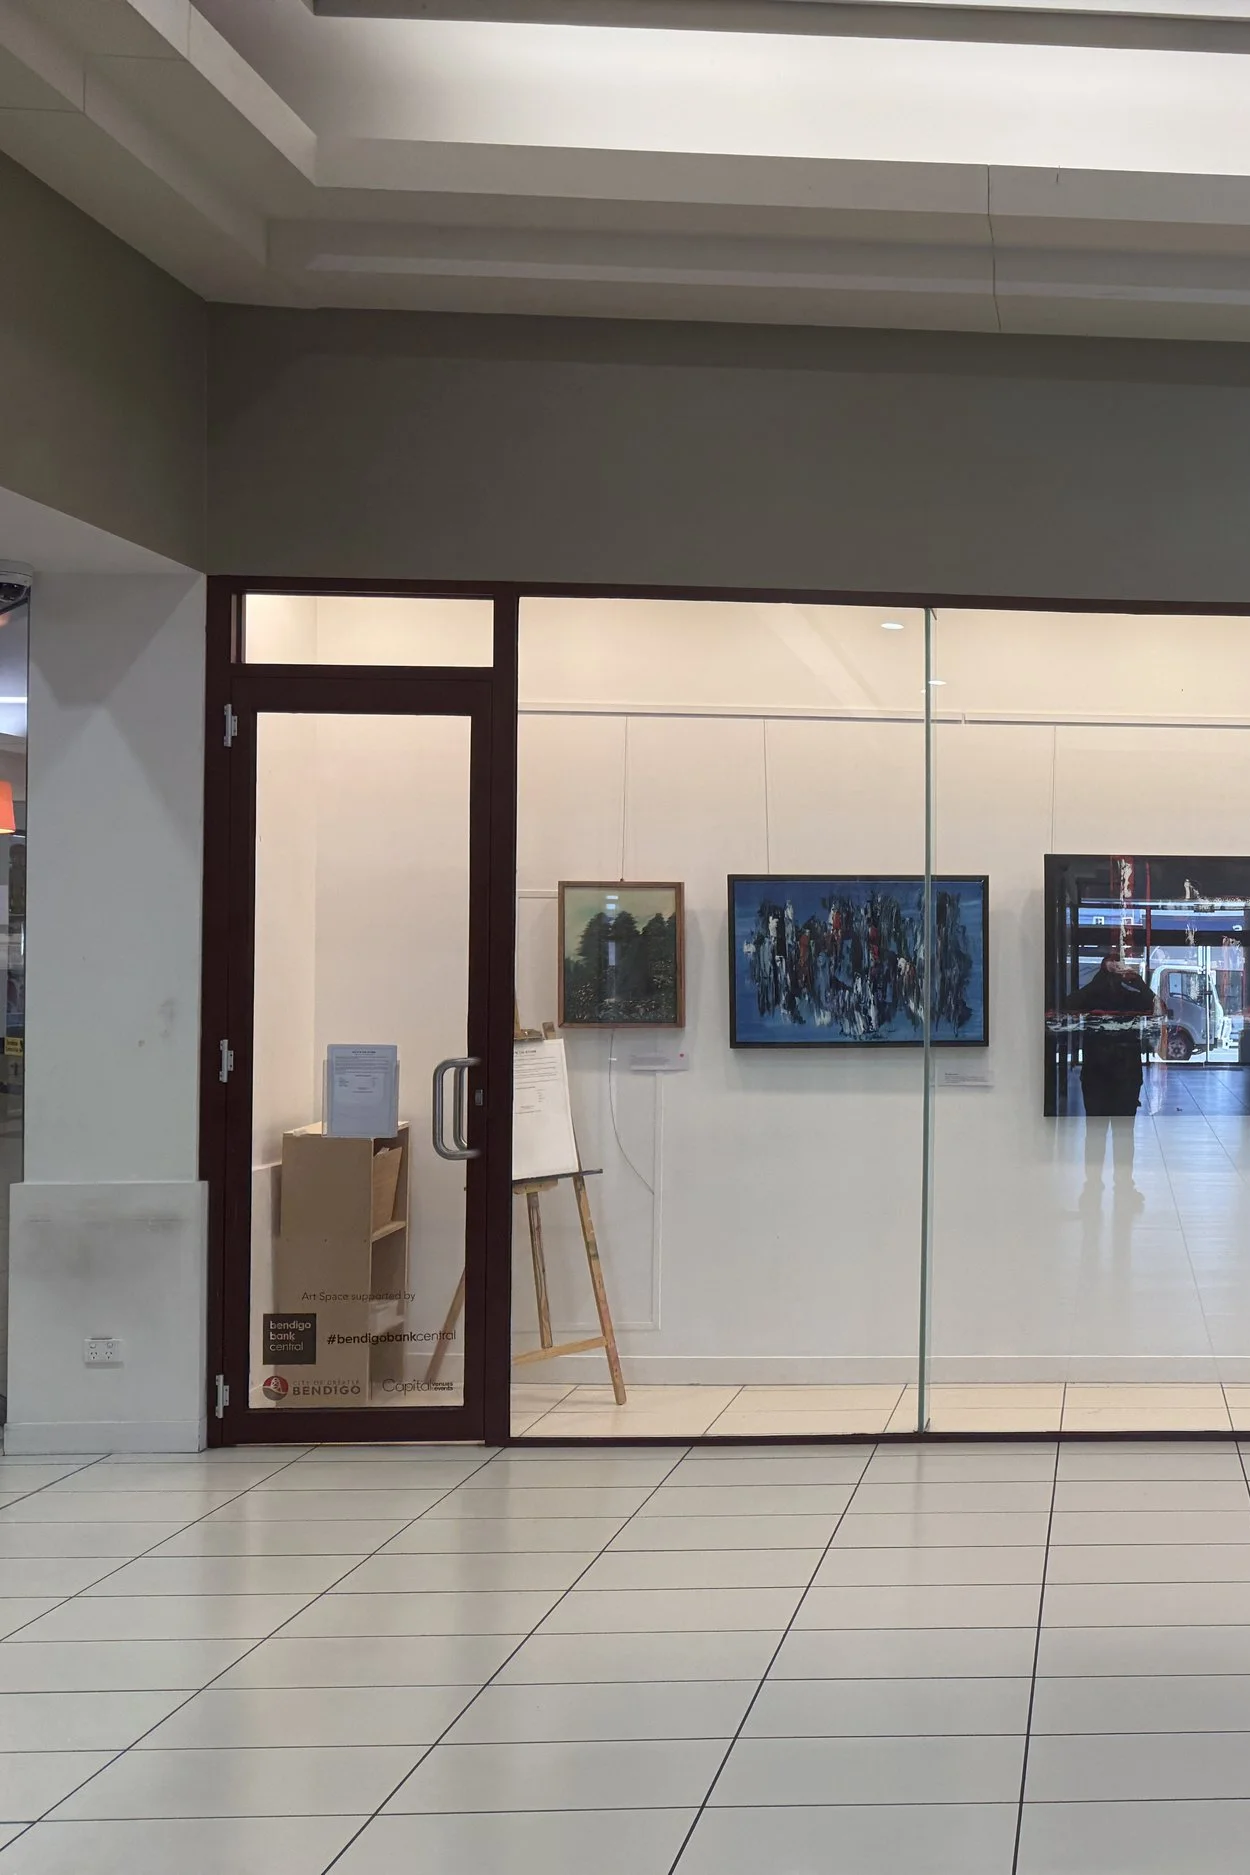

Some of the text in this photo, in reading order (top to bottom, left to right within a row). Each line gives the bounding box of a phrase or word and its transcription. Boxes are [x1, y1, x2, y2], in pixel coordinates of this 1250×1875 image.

[302, 1290, 416, 1302] Art Space supported by
[270, 1320, 312, 1331] bendigo
[270, 1331, 296, 1340] bank
[327, 1329, 456, 1346] #bendigobankcentral
[270, 1341, 304, 1351] central
[293, 1385, 361, 1395] BENDIGO
[382, 1378, 432, 1396] Capital
